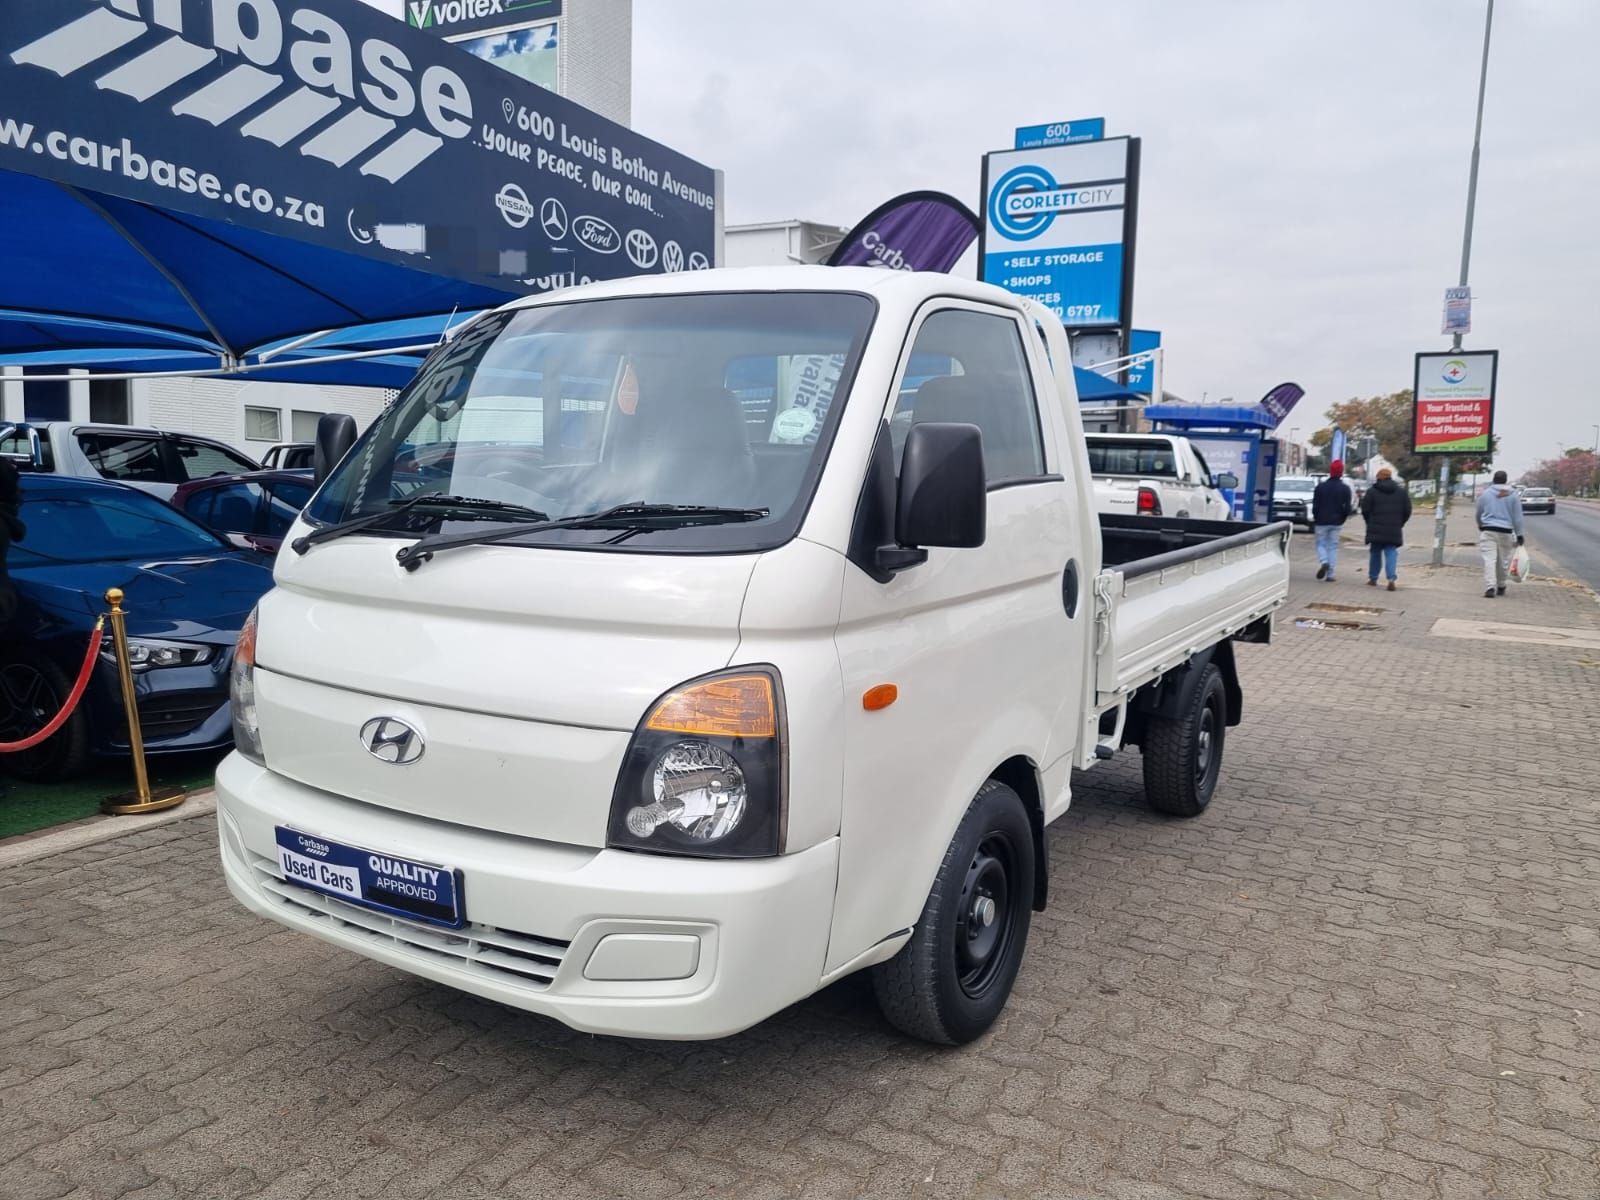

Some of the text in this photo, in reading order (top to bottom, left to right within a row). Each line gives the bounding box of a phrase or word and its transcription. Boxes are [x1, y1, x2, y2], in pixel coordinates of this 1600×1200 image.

[433, 0, 504, 25] voltex
[1046, 123, 1071, 138] 600
[517, 106, 715, 211] 600 Louis Botha Avenue
[592, 170, 622, 199] OUR
[496, 196, 533, 216] NISSAN
[581, 219, 613, 248] Ford
[1010, 252, 1104, 268] SELF STORAGE
[1010, 275, 1052, 287] SHOPS
[1067, 304, 1101, 317] 6797
[1445, 402, 1473, 412] Trusted
[1422, 413, 1483, 425] Longest Serving
[1422, 425, 1482, 435] Local Pharmacy
[298, 836, 330, 853] Carbase
[283, 853, 354, 892] Used Cars
[368, 855, 439, 887] QUALITY
[376, 876, 437, 902] APPROVED
